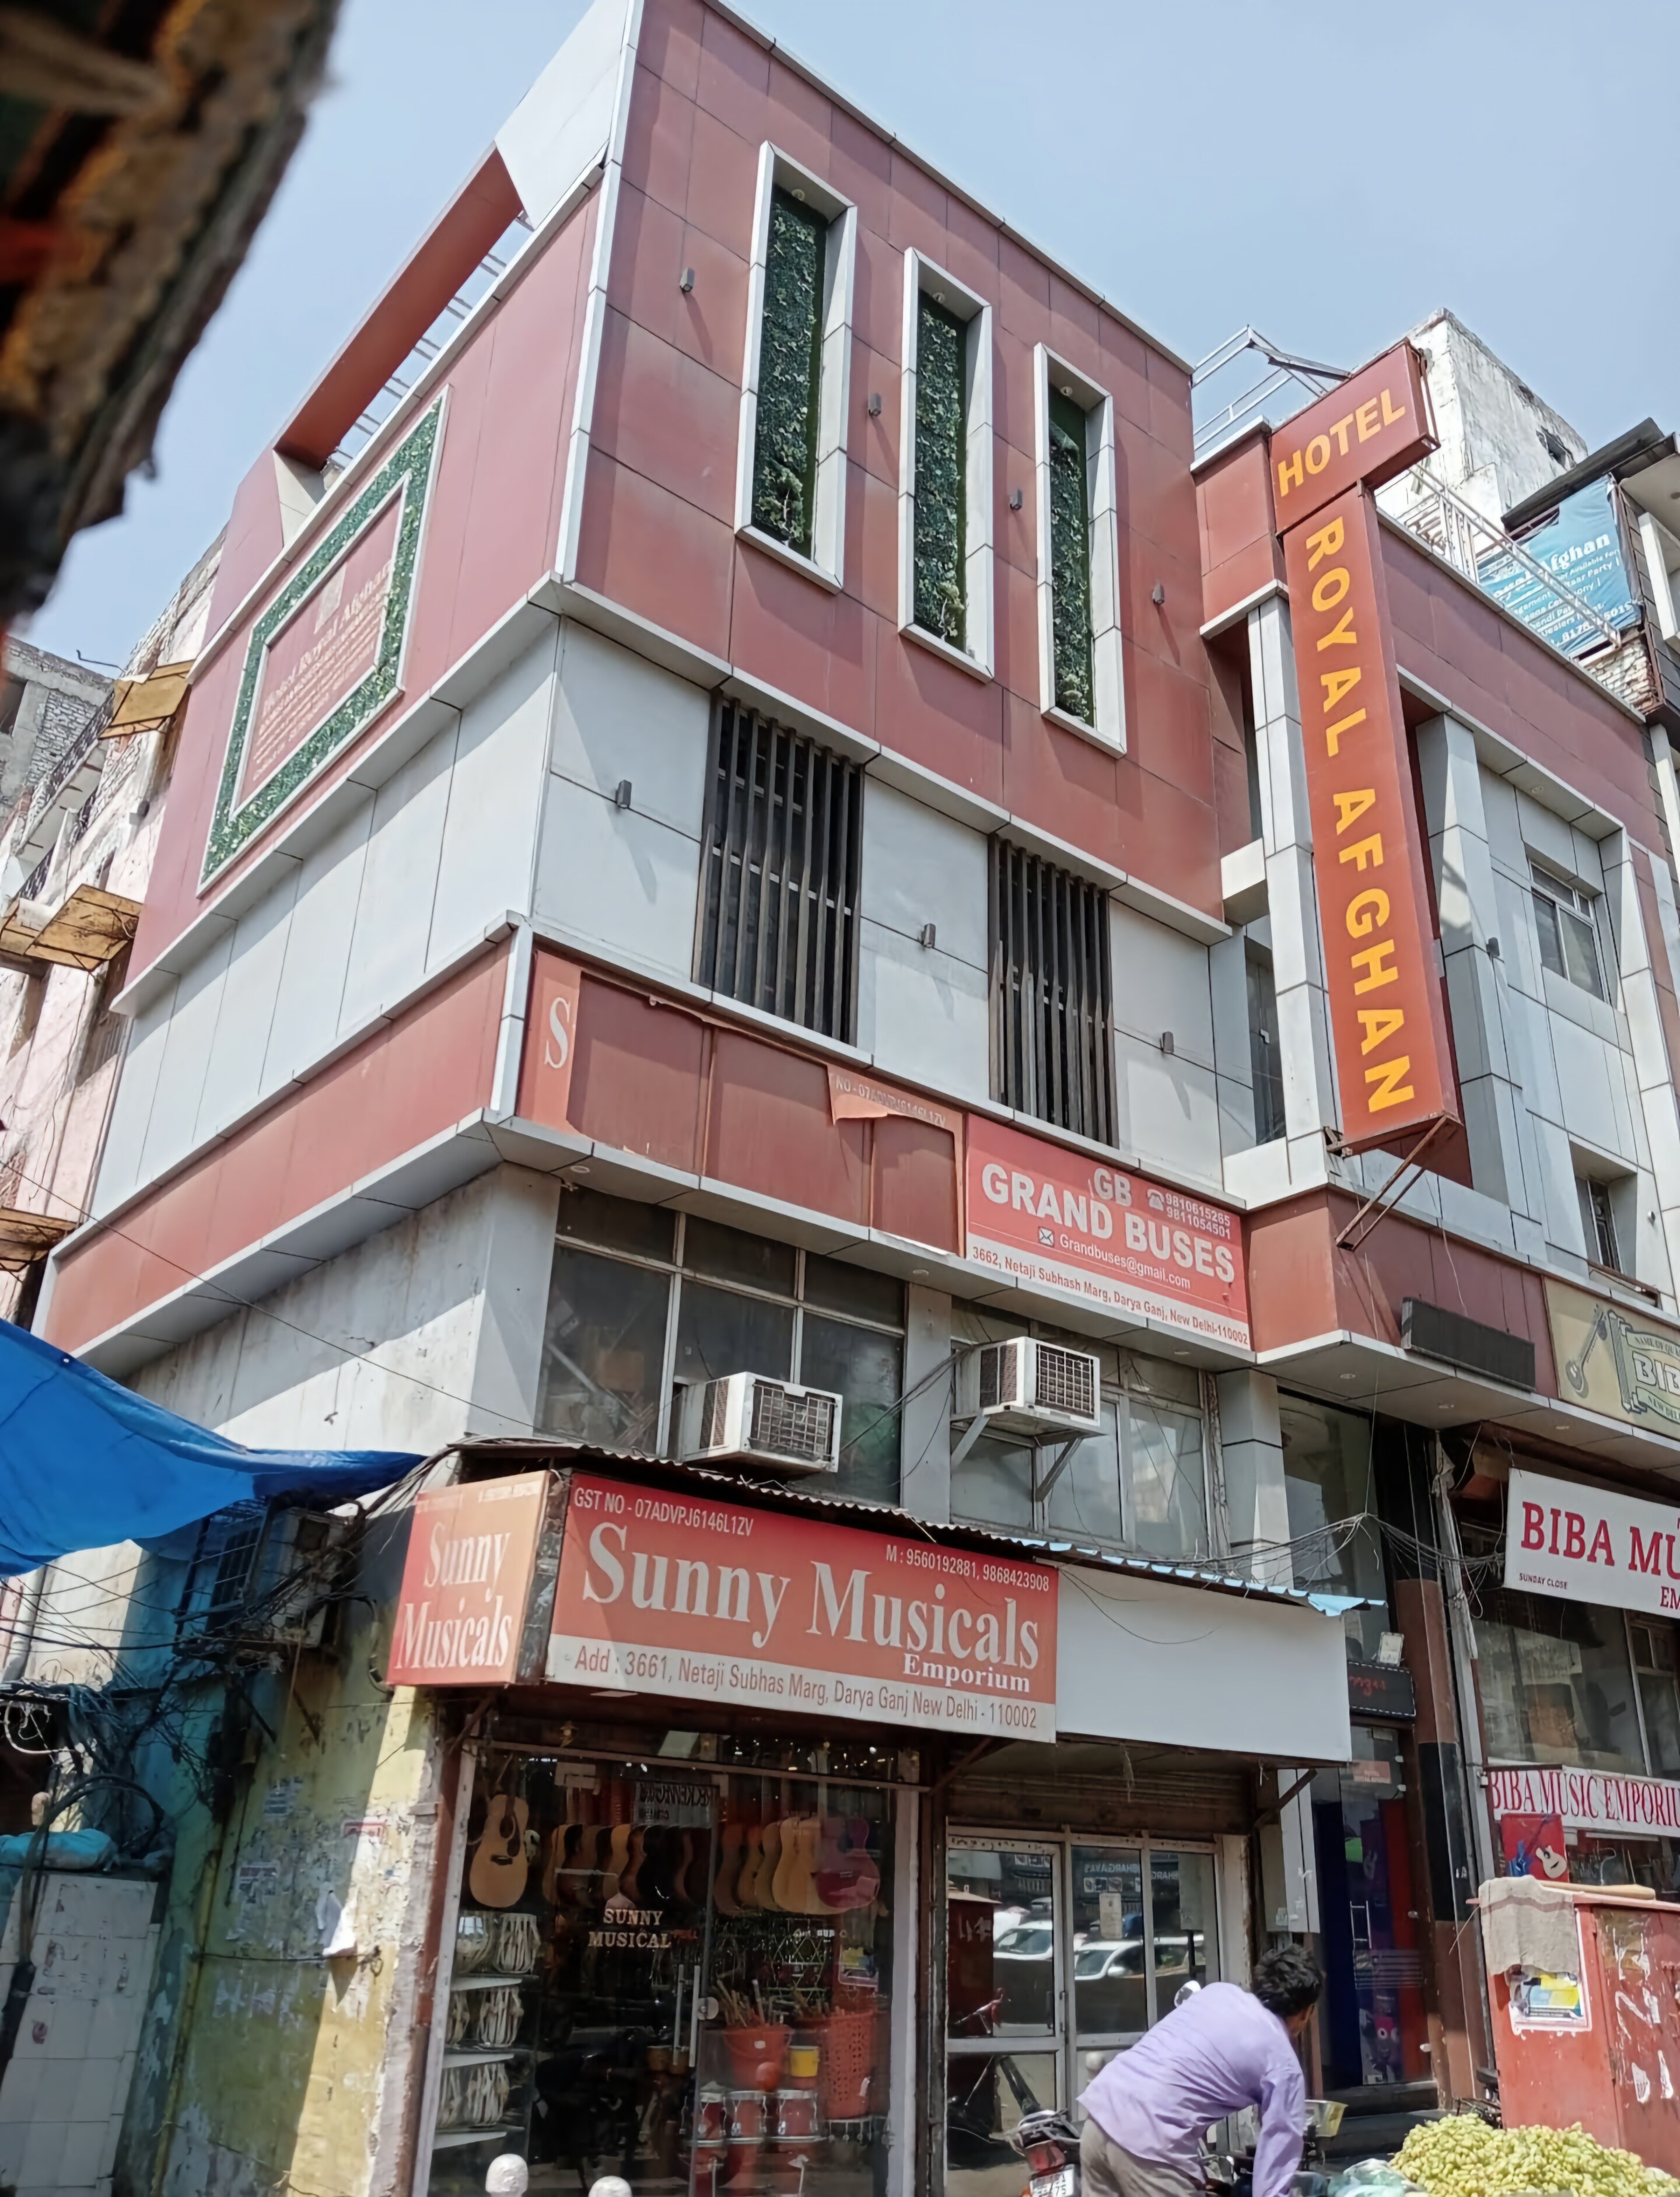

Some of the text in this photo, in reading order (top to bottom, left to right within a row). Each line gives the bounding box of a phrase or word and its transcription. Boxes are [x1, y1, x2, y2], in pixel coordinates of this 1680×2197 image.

[1278, 389, 1406, 498] HOTEL
[1306, 516, 1415, 1113] ROYAL AFGHAN
[544, 997, 570, 1069] S
[1093, 1167, 1132, 1207] GB
[982, 1163, 1235, 1283] GRAND BUSES
[1167, 1206, 1230, 1240] 9811054501
[973, 1247, 1001, 1269] 3662,
[1005, 1257, 1035, 1279] Netaji
[1039, 1268, 1081, 1291] Subhash
[1084, 1281, 1111, 1303] Marg,
[1114, 1290, 1141, 1311] Darya
[1144, 1301, 1167, 1321] Ganj,
[1170, 1309, 1191, 1326] New
[1060, 1233, 1191, 1290] Grandbuses@gmail.com
[574, 1488, 602, 1510] GST
[604, 1492, 625, 1514] NO
[635, 1499, 754, 1536] 07ADVPJ6146L1ZV
[1521, 1501, 1615, 1566] BIBA
[424, 1521, 511, 1603] Sunny
[983, 1564, 1049, 1591] 9868423908
[1519, 1573, 1567, 1589] SUNDAY CLOSE
[583, 1521, 1039, 1670] Sunny Musicals
[394, 1595, 512, 1669] Musicals
[575, 1645, 610, 1673] Add
[625, 1651, 673, 1683] 3661,
[678, 1658, 724, 1691] Netaji
[729, 1664, 783, 1694] Subhas
[789, 1673, 828, 1706] Marg,
[834, 1680, 873, 1712] Darya
[878, 1687, 908, 1717] Ganj
[912, 1691, 943, 1716] New
[947, 1696, 978, 1722] Delhi
[990, 1702, 1037, 1729] 110002
[903, 1653, 1030, 1692] Emporium
[1490, 1771, 1535, 1812] BIBA
[1538, 1770, 1598, 1819] MUSIC
[588, 1932, 671, 1948] MUSICAL
[603, 1908, 663, 1925] SUNNY
